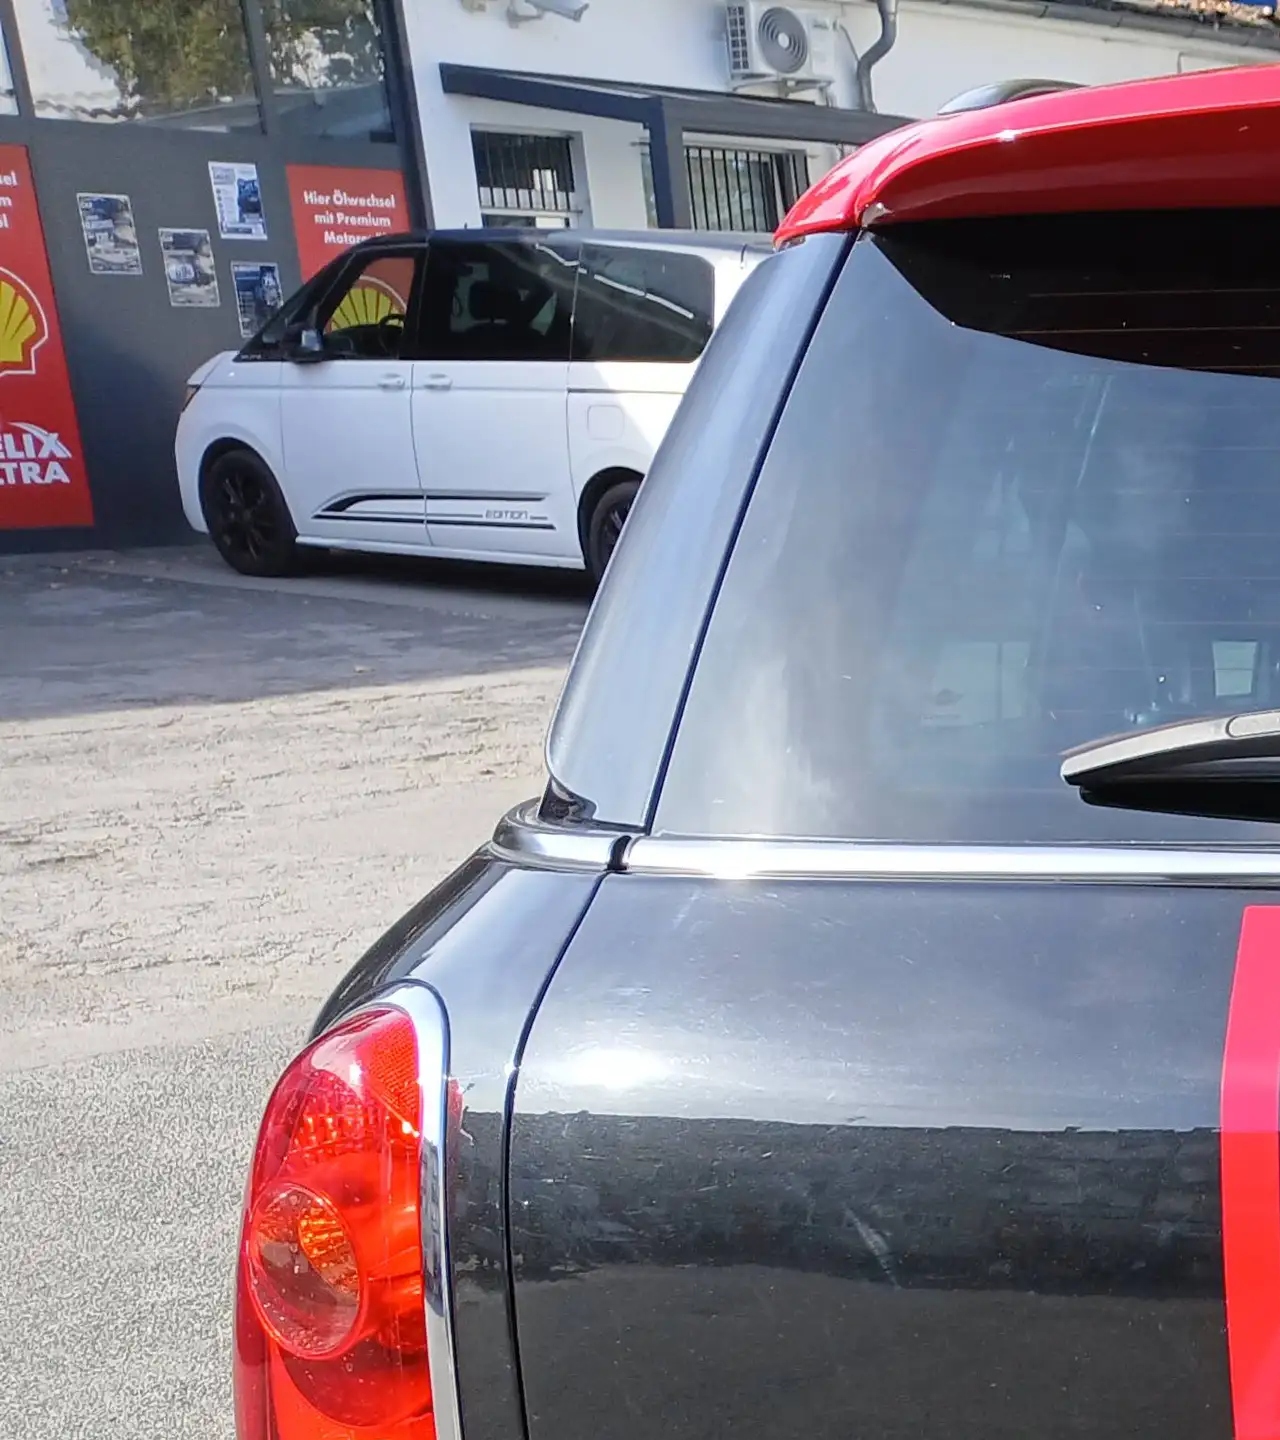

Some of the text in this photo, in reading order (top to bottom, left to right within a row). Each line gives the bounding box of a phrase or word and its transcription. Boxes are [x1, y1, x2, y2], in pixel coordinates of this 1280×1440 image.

[302, 188, 396, 209] Hier Ölwechsel
[314, 210, 392, 228] mit Premium
[0, 460, 71, 486] TRA
[485, 509, 529, 520] EDITION
